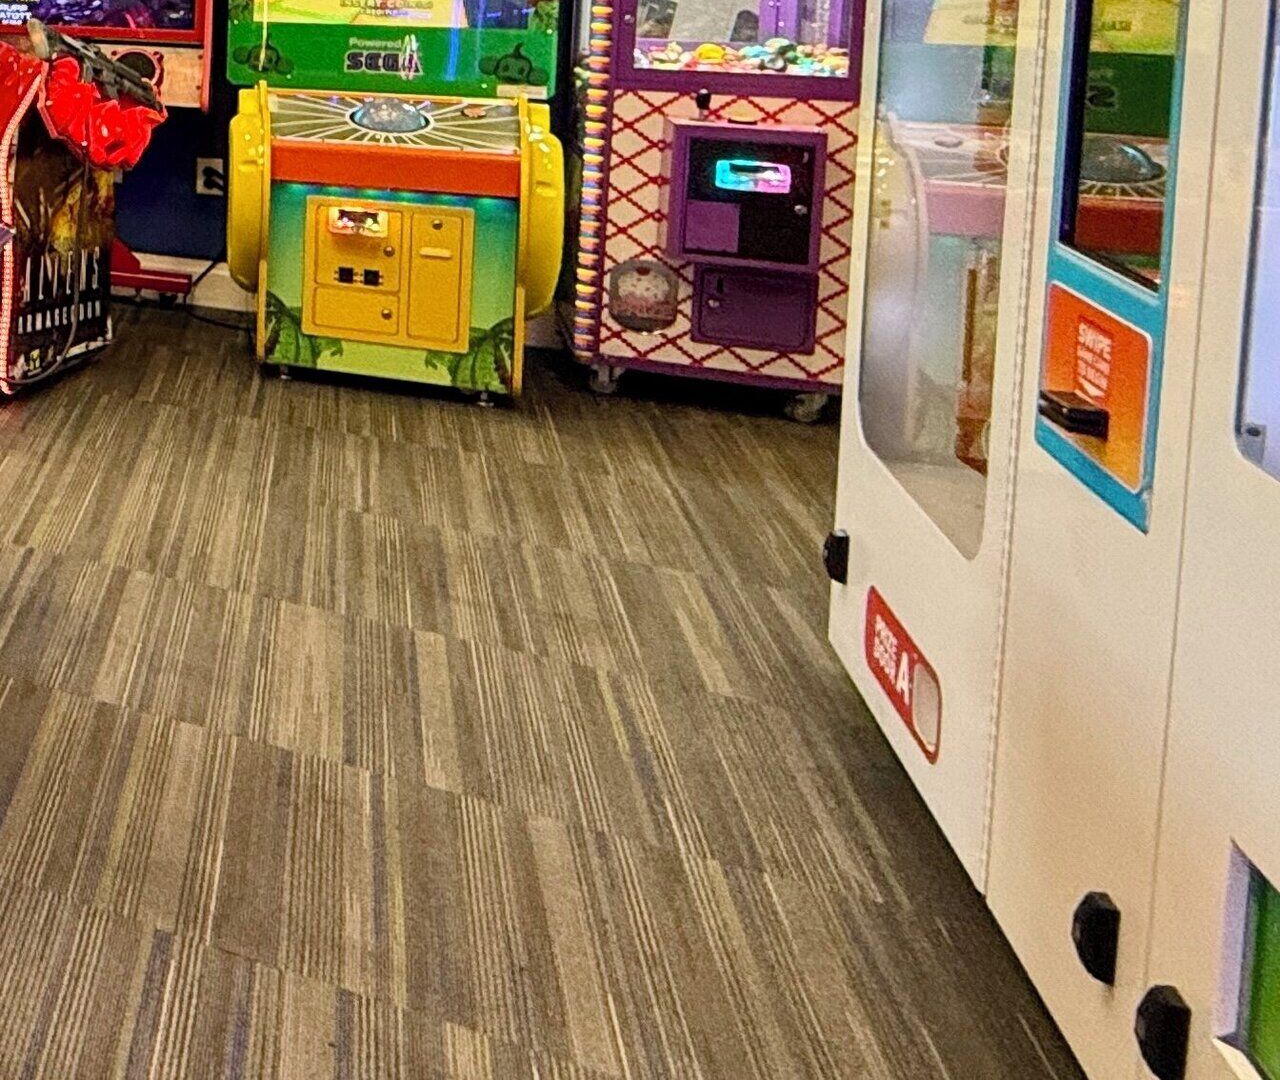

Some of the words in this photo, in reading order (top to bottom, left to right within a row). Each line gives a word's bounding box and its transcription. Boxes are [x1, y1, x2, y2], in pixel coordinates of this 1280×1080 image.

[348, 37, 402, 49] Powered
[345, 51, 421, 73] SEGA
[896, 651, 910, 707] A
